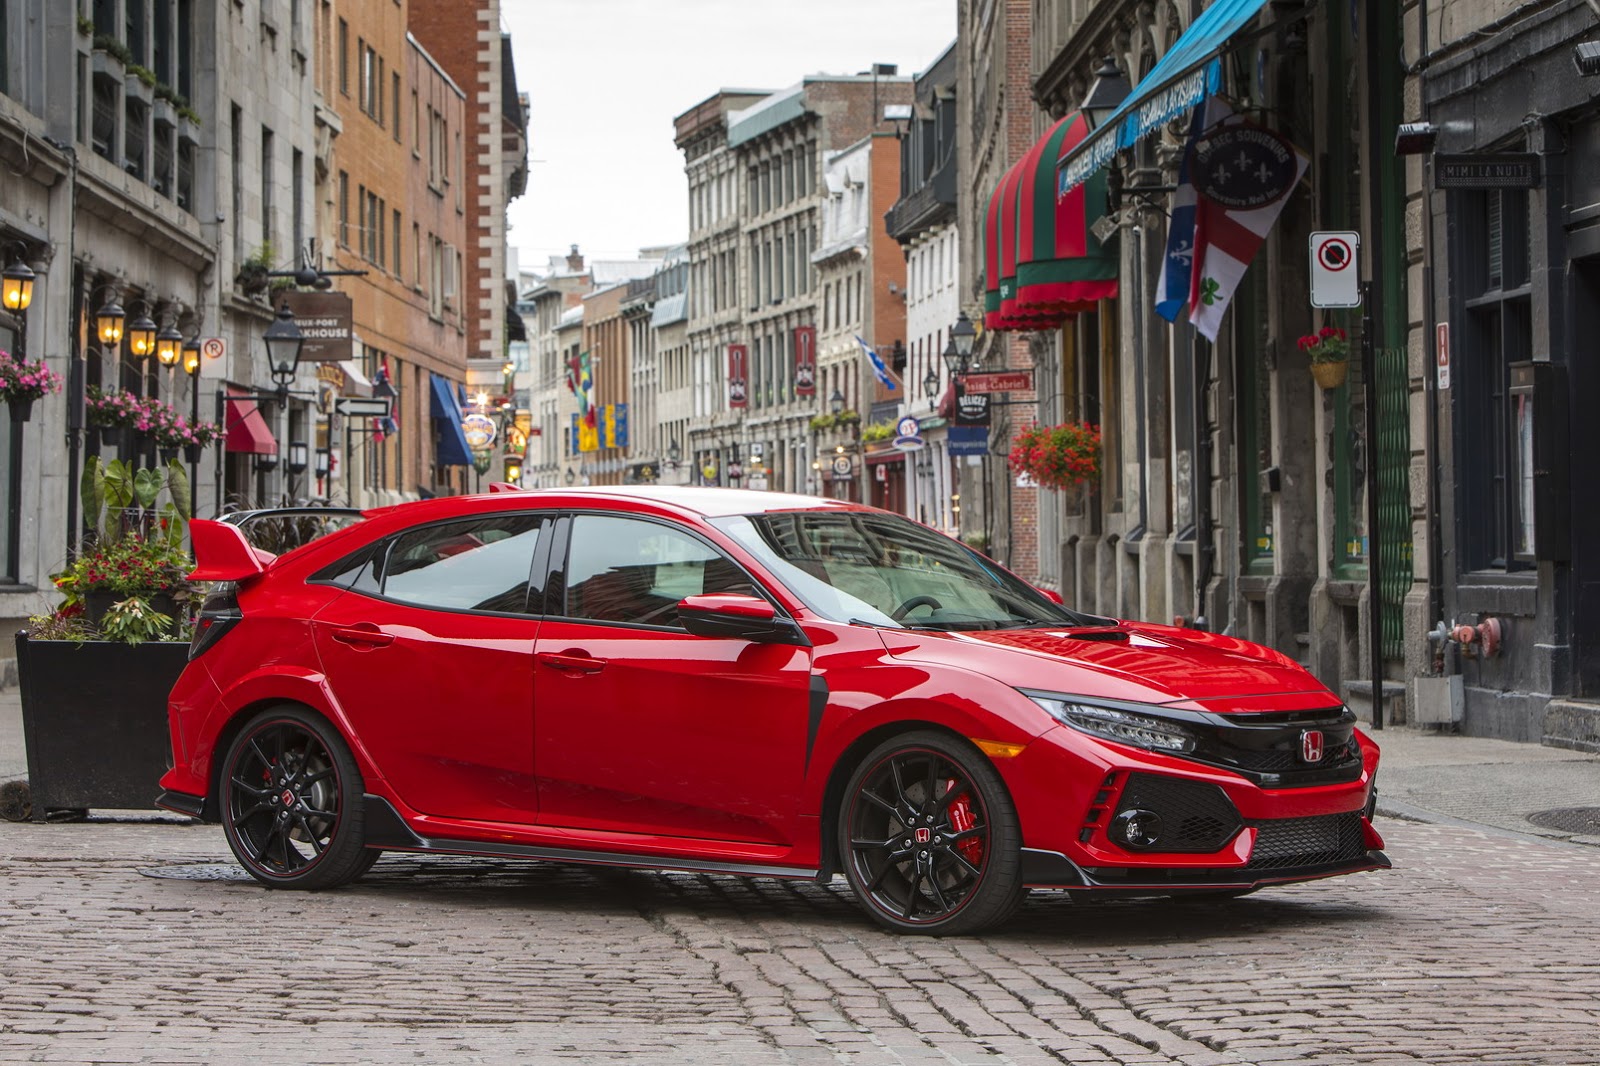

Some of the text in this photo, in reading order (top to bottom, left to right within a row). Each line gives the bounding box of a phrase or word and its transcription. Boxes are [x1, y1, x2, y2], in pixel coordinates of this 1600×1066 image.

[1236, 130, 1290, 163] SOUVENIRS
[1447, 165, 1525, 176] MIMI LA NUIT
